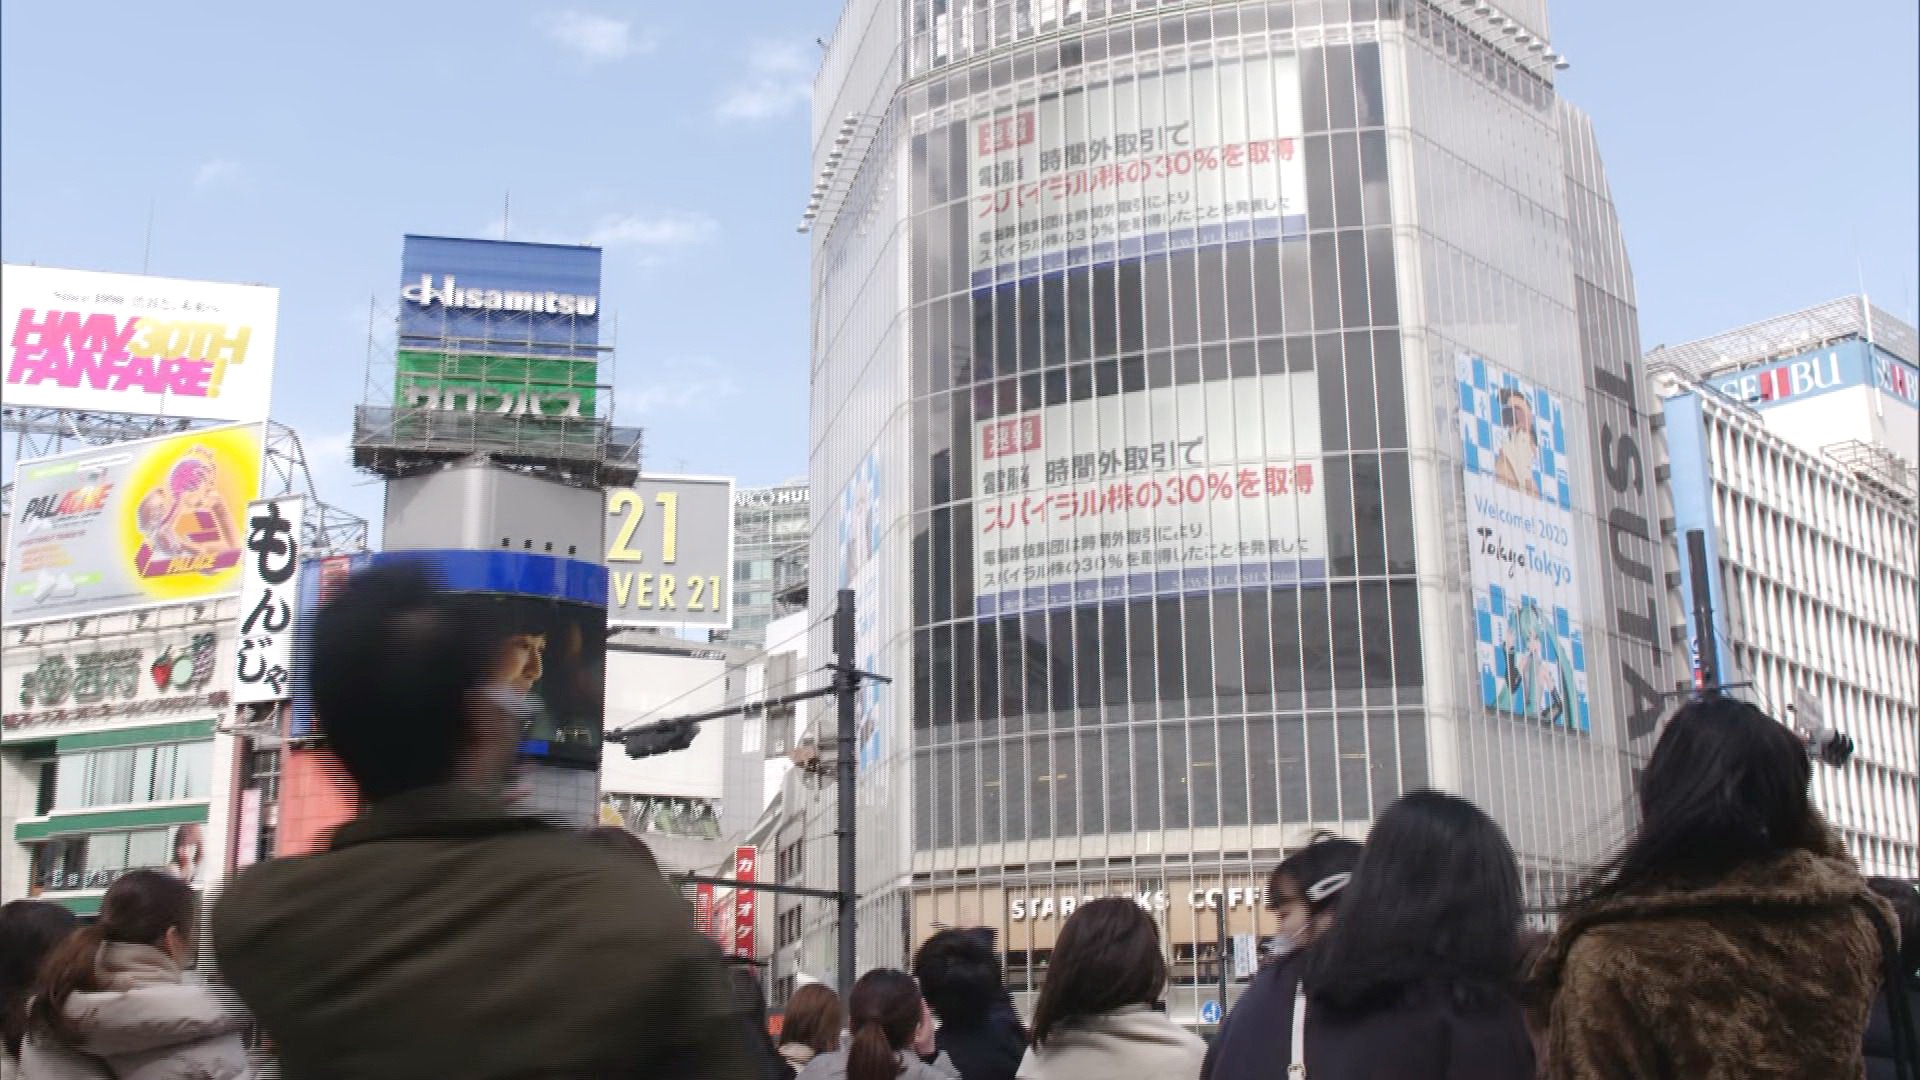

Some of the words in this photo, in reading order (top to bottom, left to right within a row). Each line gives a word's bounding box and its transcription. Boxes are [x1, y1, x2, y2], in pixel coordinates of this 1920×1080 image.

[403, 273, 598, 316] Hisamitsu
[6, 348, 227, 398] FANFARE!
[1720, 352, 1841, 404] SEIBU
[1046, 435, 1204, 485] 時間外取引で
[608, 488, 677, 562] 21
[1473, 493, 1535, 534] Welcome!
[1538, 519, 1568, 547] 2020
[1476, 527, 1526, 578] Tokyo
[1525, 543, 1572, 586] Tokyo
[238, 501, 299, 695] もんじゃ
[612, 572, 678, 610] VER
[687, 575, 721, 611] 21
[1011, 891, 1171, 921] STARKS
